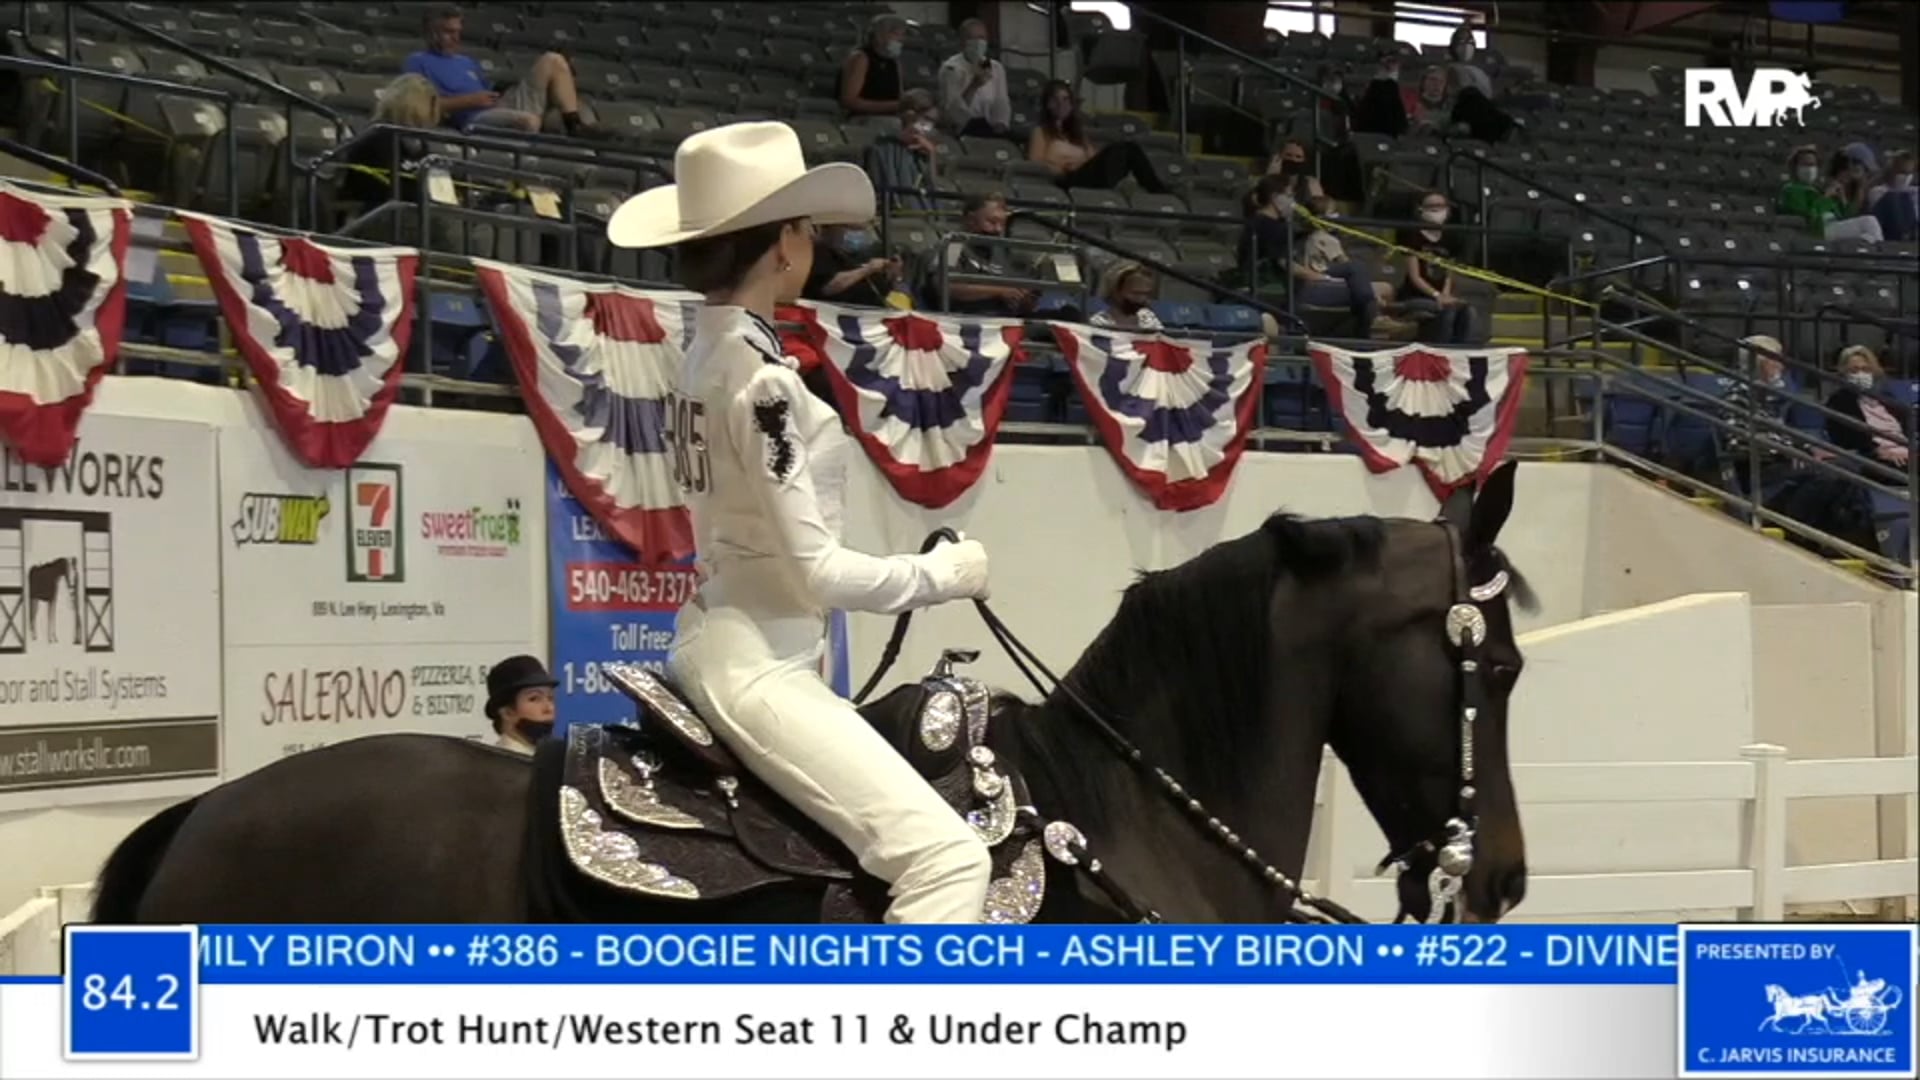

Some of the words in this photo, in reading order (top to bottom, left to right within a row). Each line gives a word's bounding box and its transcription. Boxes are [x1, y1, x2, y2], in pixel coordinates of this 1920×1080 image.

[232, 491, 331, 548] SUBWAY
[610, 623, 637, 651] Toll
[29, 667, 59, 703] and
[63, 666, 97, 701] Stall
[101, 668, 167, 710] Systems
[261, 667, 406, 726] SALERNO
[427, 694, 474, 716] BISTRO
